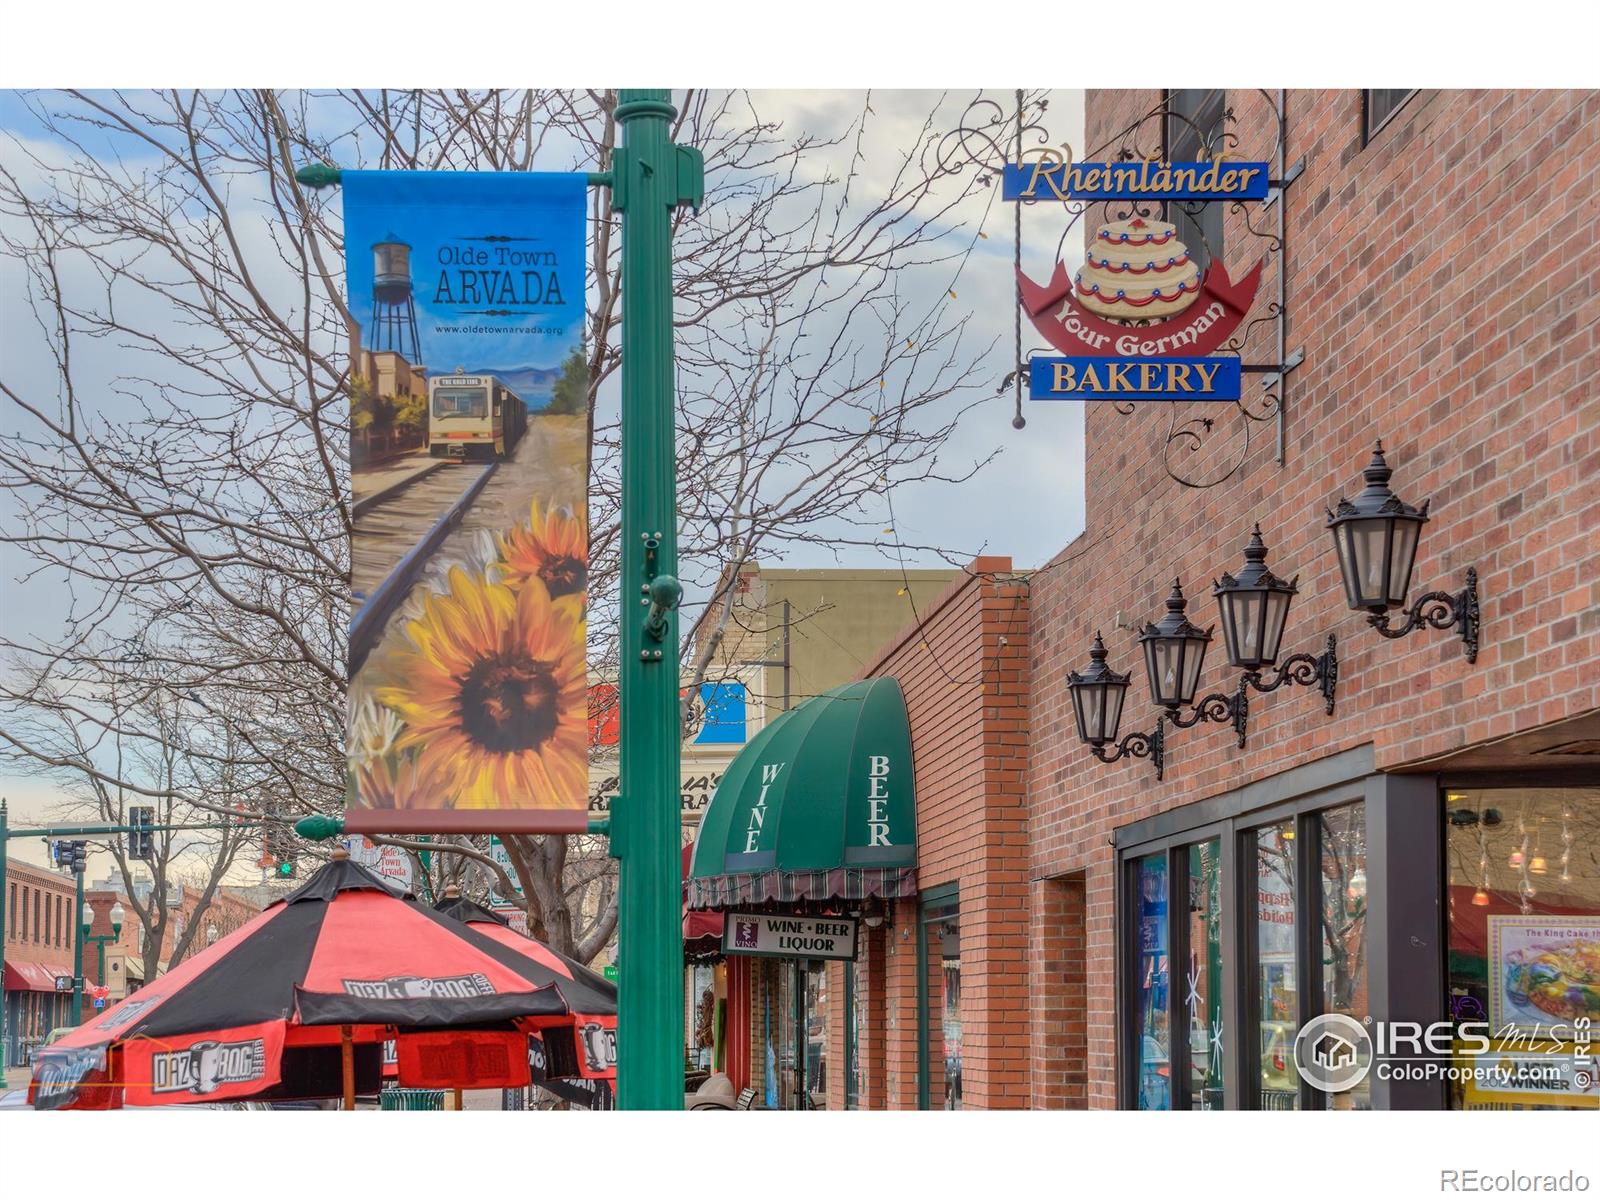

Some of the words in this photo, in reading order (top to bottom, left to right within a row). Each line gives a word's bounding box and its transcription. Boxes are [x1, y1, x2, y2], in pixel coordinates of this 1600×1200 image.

[1018, 143, 1259, 200] Rheinländer
[438, 247, 488, 266] Olde
[494, 247, 558, 266] Town
[433, 270, 566, 305] ARVADA
[435, 325, 563, 336] www.oldetownarvada.org
[1055, 301, 1111, 350] Your
[1115, 302, 1227, 357] German
[1050, 363, 1221, 393] BAKERY
[743, 762, 786, 853] WINE
[867, 755, 893, 847] BEER
[767, 920, 804, 933] WINE
[815, 923, 849, 936] BEER
[1526, 928, 1541, 936] The
[1566, 929, 1588, 937] Cake
[735, 940, 758, 948] VINO
[779, 936, 835, 951] LIQUOR
[1508, 1079, 1570, 1091] WINNER
